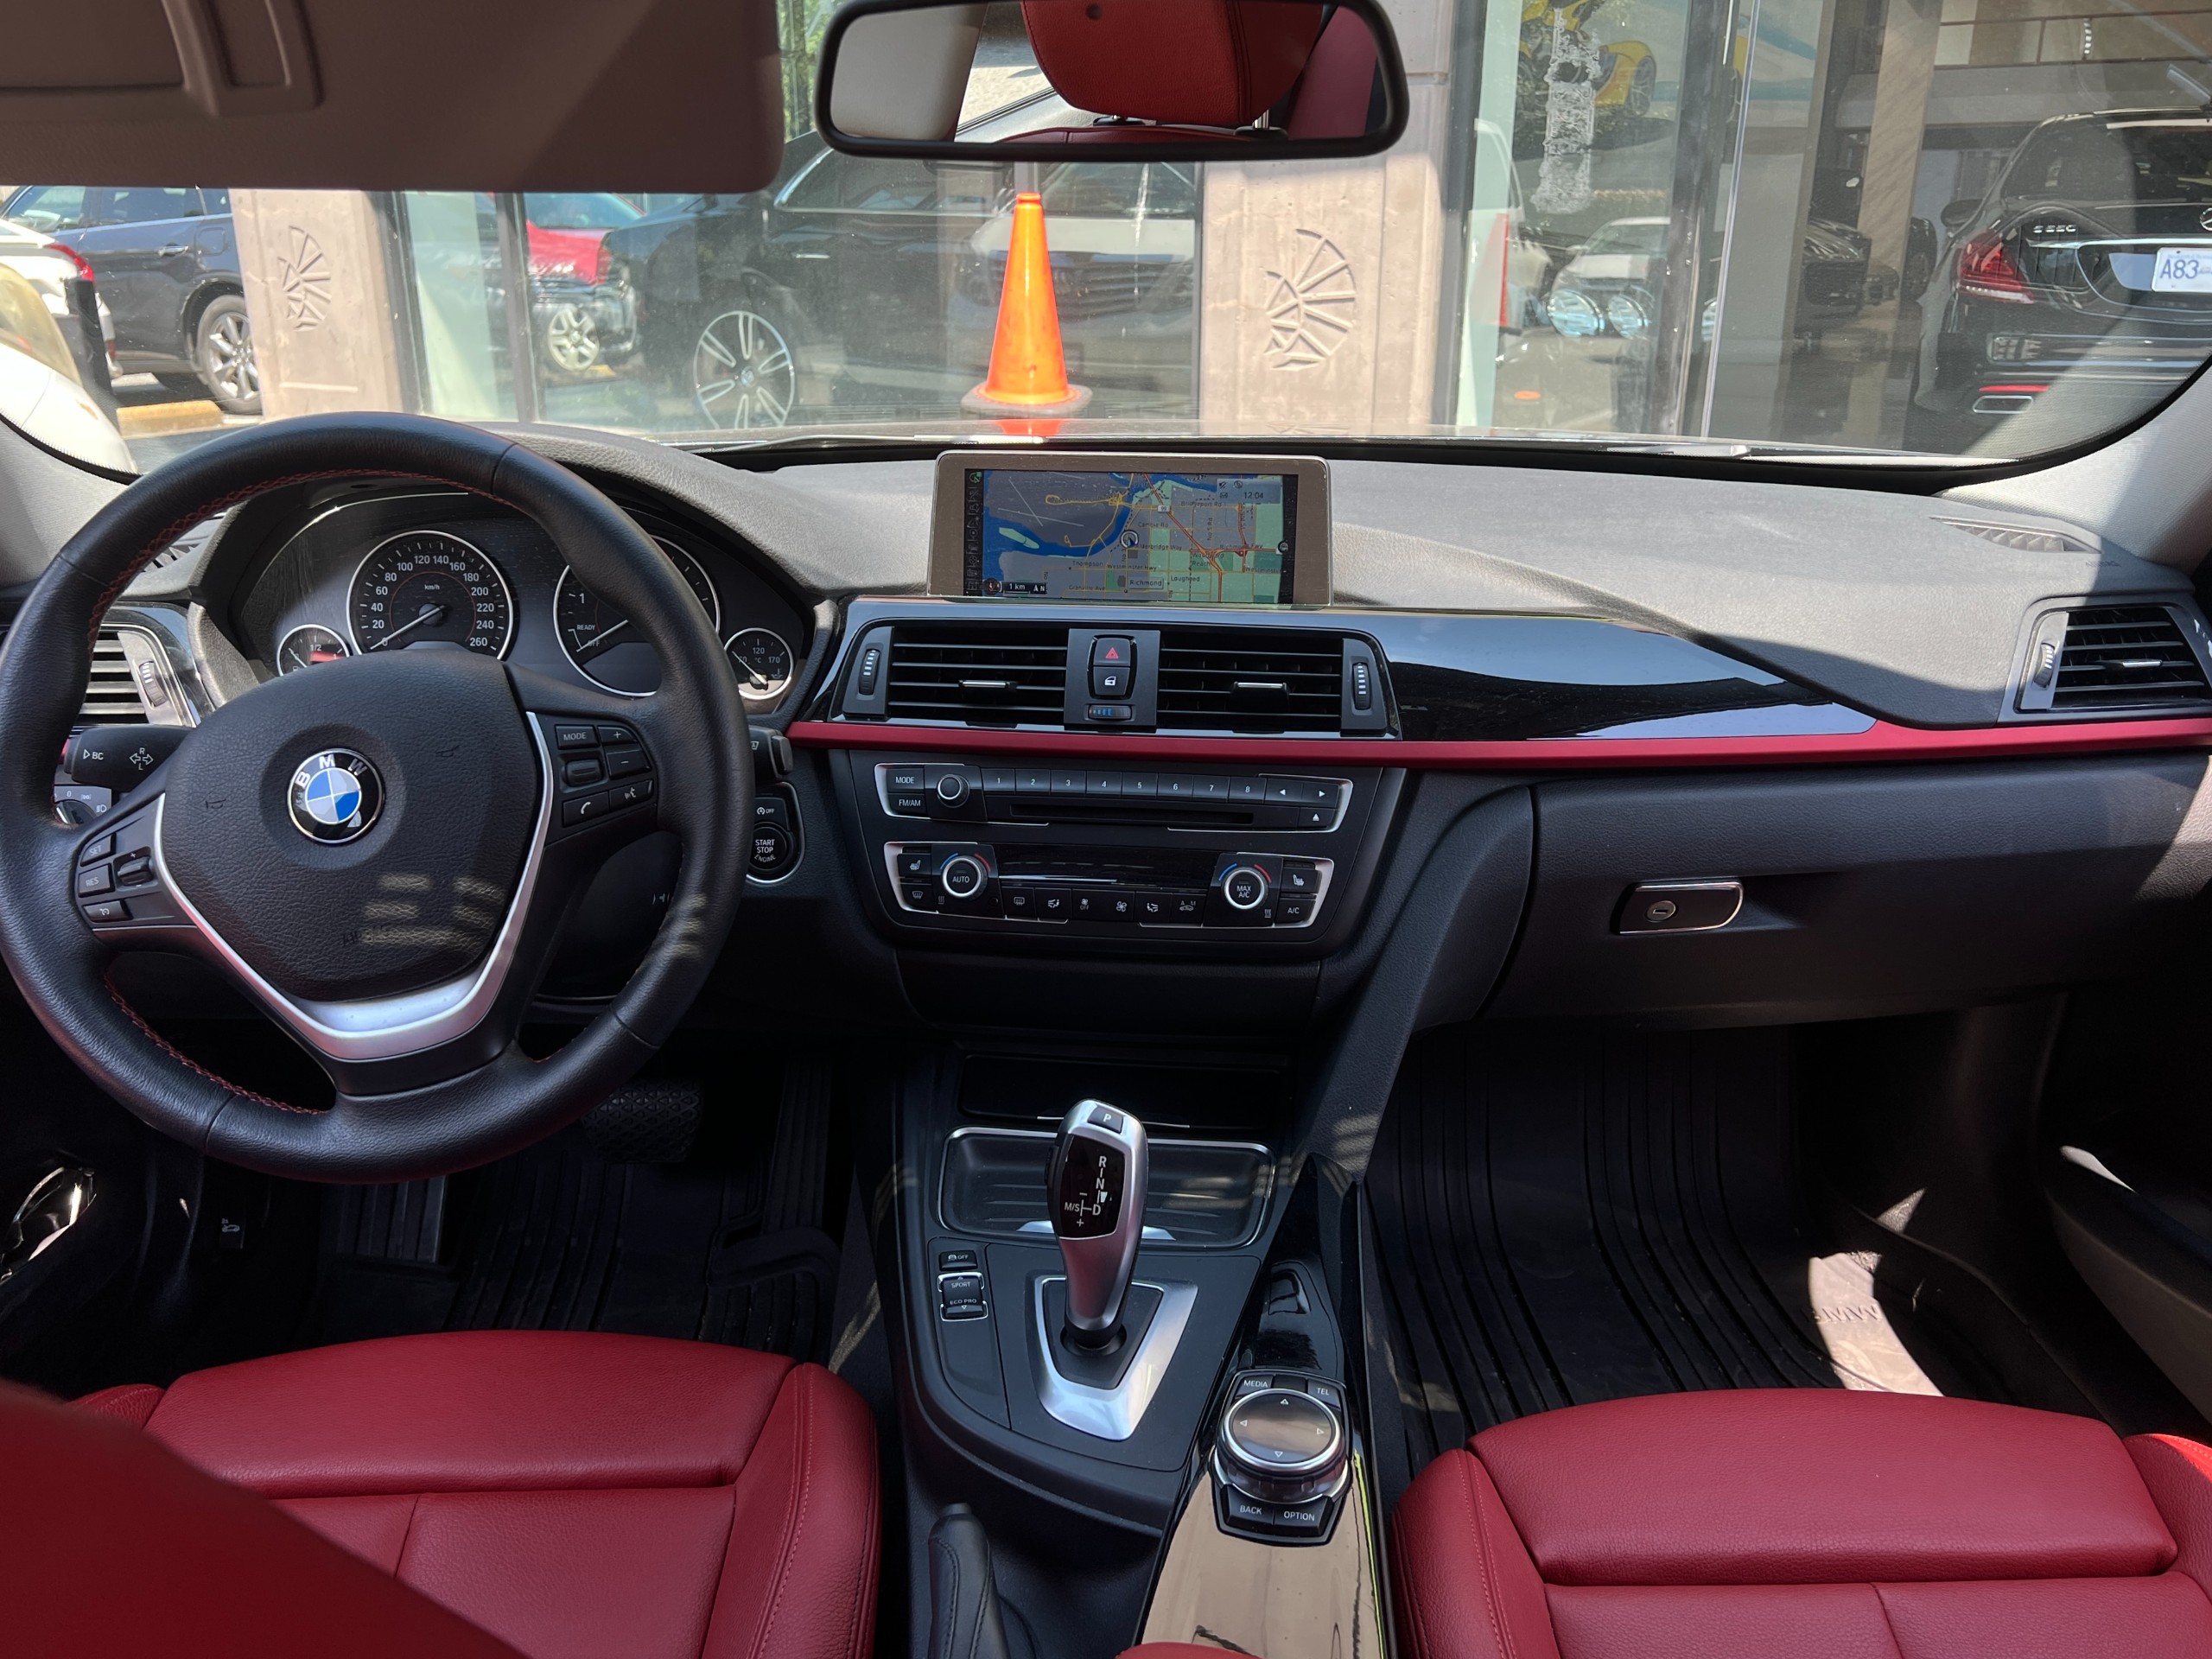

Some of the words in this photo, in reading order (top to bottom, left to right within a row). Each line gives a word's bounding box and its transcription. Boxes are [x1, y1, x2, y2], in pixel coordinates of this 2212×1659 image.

[414, 555, 430, 564] 120
[433, 555, 449, 564] 140
[397, 562, 413, 571] 100
[449, 562, 465, 571] 160
[385, 573, 397, 582] 80
[463, 573, 479, 582] 180
[376, 586, 388, 596] 60
[471, 587, 488, 596] 200
[579, 593, 584, 603] 1
[371, 603, 383, 612] 40
[477, 603, 494, 612] 220
[372, 620, 384, 629] 20
[477, 620, 494, 629] 240
[470, 637, 488, 647] 260
[564, 731, 587, 741] MODE
[92, 752, 104, 760] BC
[294, 754, 367, 788] BMW
[90, 845, 101, 856] SET
[754, 854, 776, 863] ENGINE
[86, 877, 99, 886] RES
[1103, 1114, 1111, 1122] P
[1099, 1156, 1107, 1167] R
[1096, 1178, 1105, 1190] N
[1064, 1202, 1080, 1212] M/S
[1092, 1204, 1101, 1215] D
[1240, 1505, 1262, 1515] BACK
[1284, 1511, 1315, 1521] OPTION
